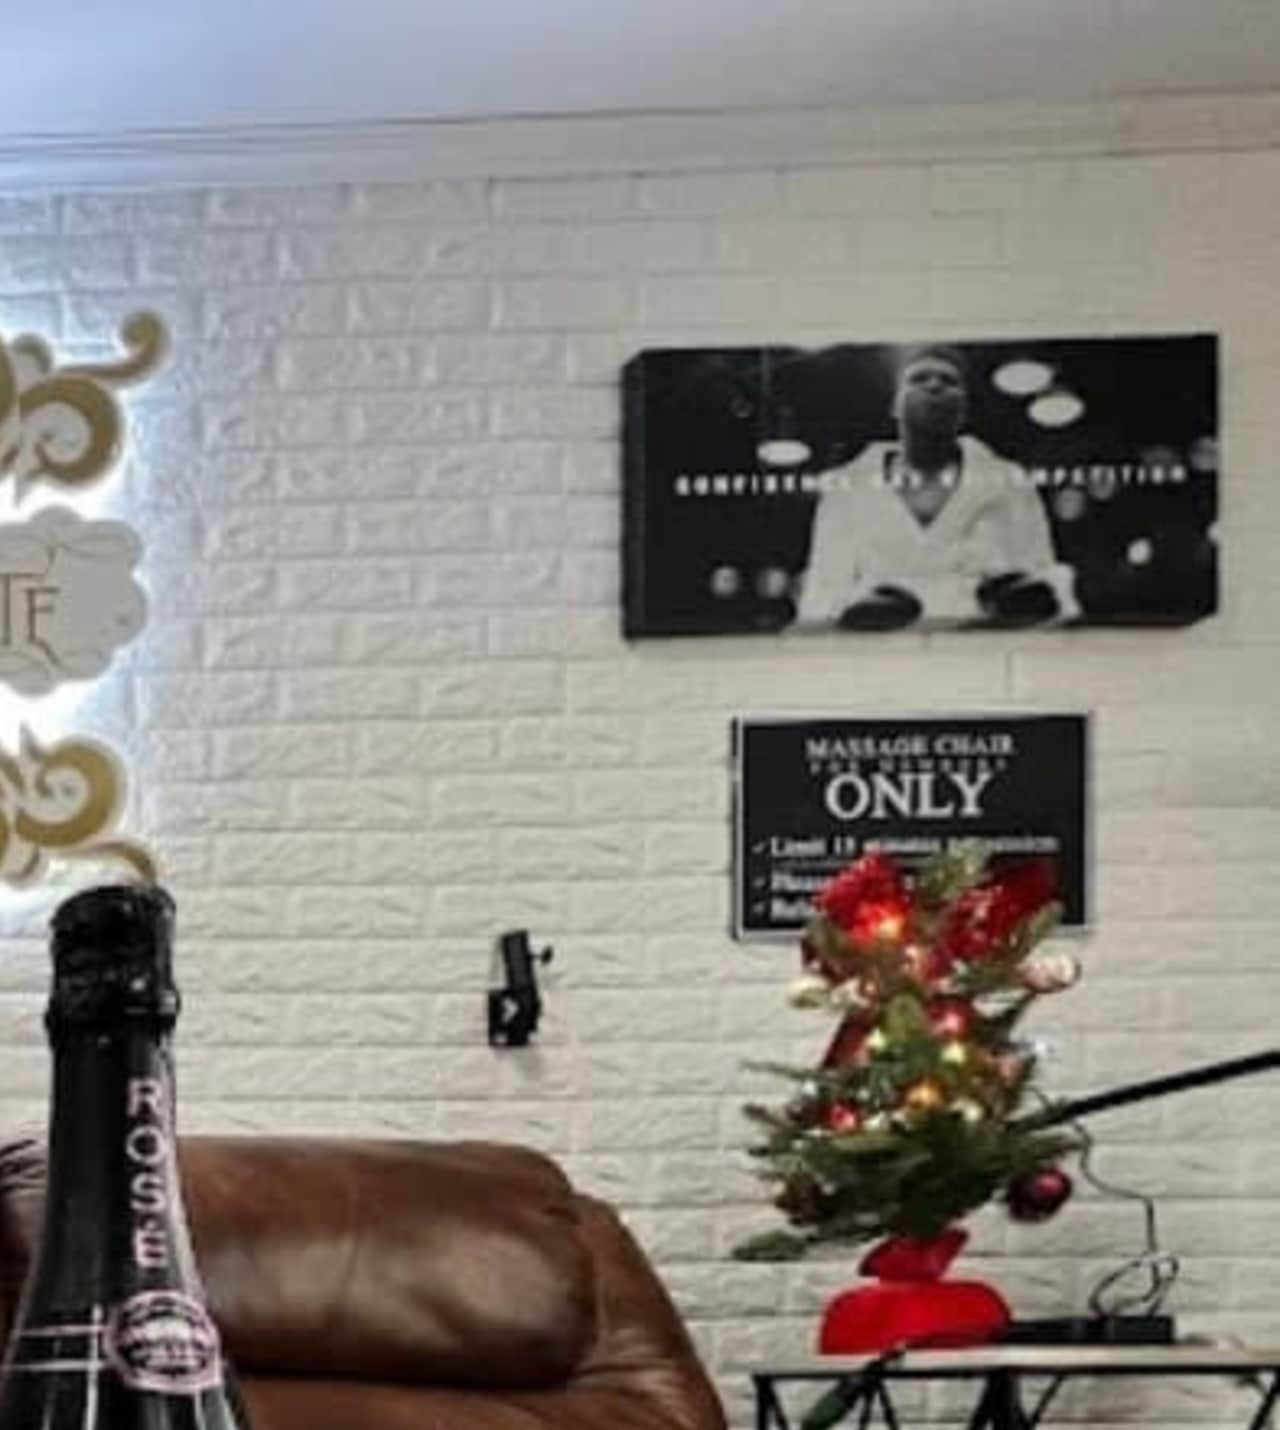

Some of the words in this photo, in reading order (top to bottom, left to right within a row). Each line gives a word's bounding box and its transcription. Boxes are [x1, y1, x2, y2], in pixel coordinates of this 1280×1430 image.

[674, 474, 851, 496] CONFIDEN
[805, 735, 930, 760] MASSAGE
[933, 733, 1014, 756] CHAIR
[825, 771, 994, 820] ONLY
